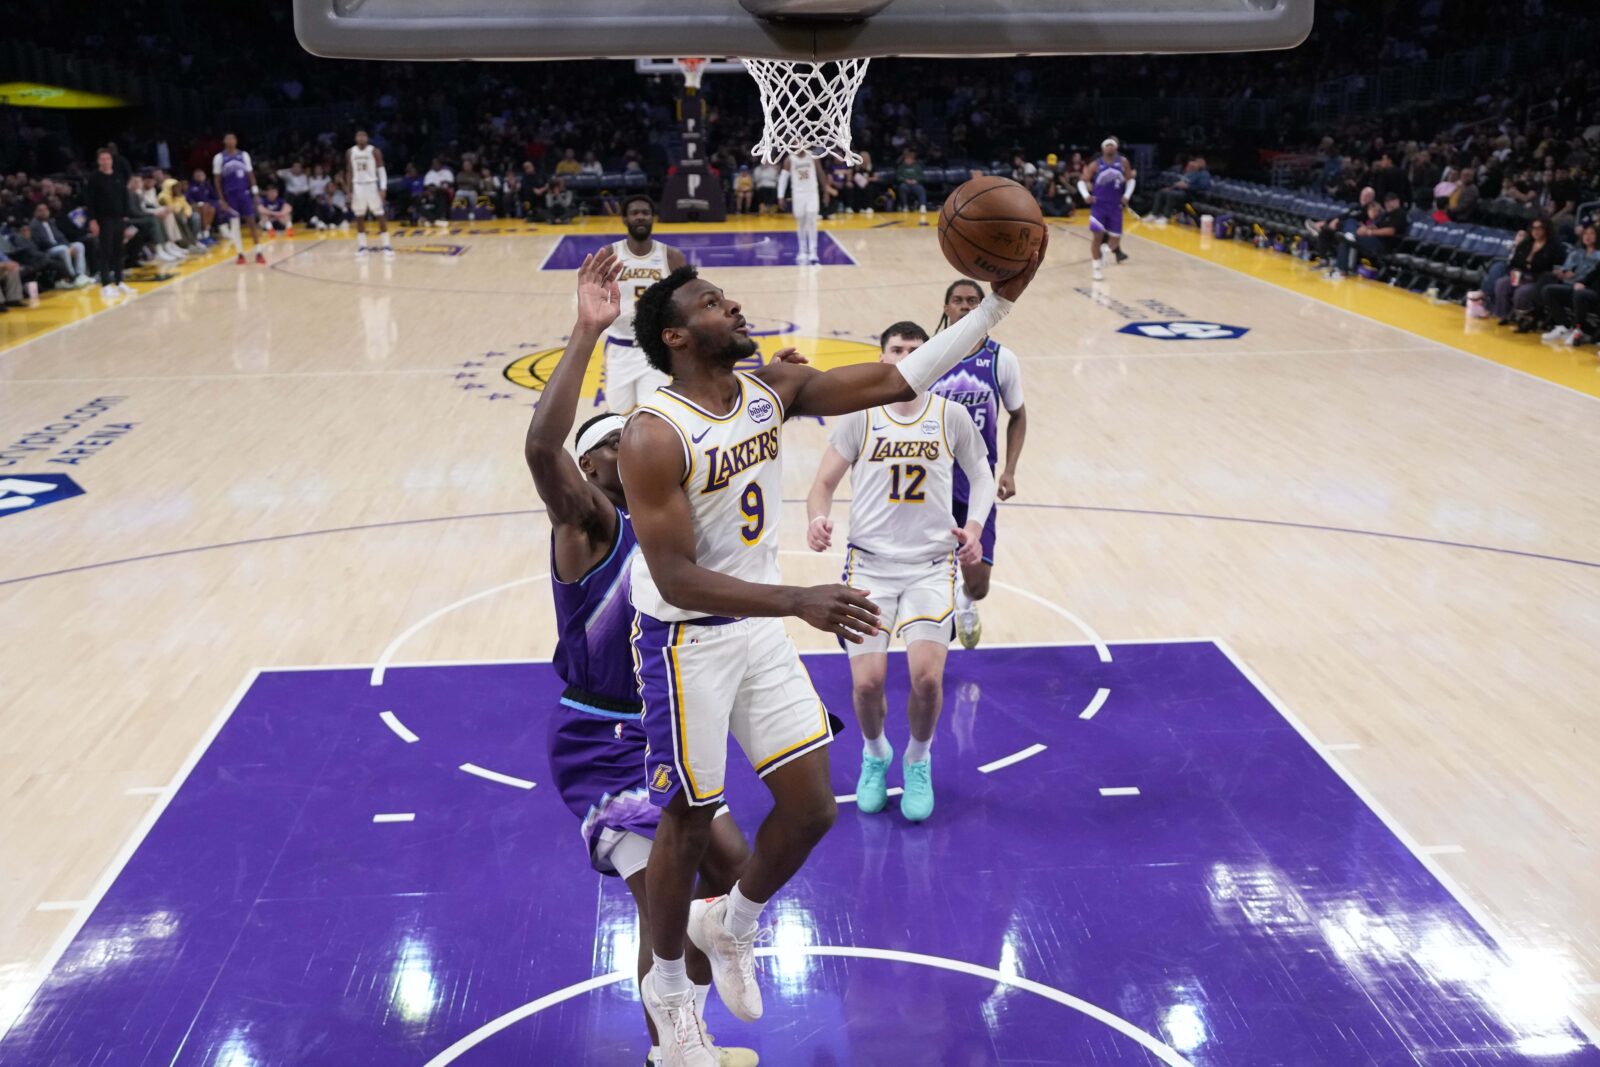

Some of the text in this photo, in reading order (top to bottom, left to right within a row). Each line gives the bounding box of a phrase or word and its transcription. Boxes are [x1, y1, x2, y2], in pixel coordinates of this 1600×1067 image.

[618, 266, 662, 281] LAKERS
[750, 403, 771, 416] bibigo
[45, 421, 143, 465] ARENA
[701, 426, 778, 494] LAKERS
[868, 437, 939, 461] LAKERS
[888, 464, 927, 503] 12
[740, 480, 765, 546] 9
